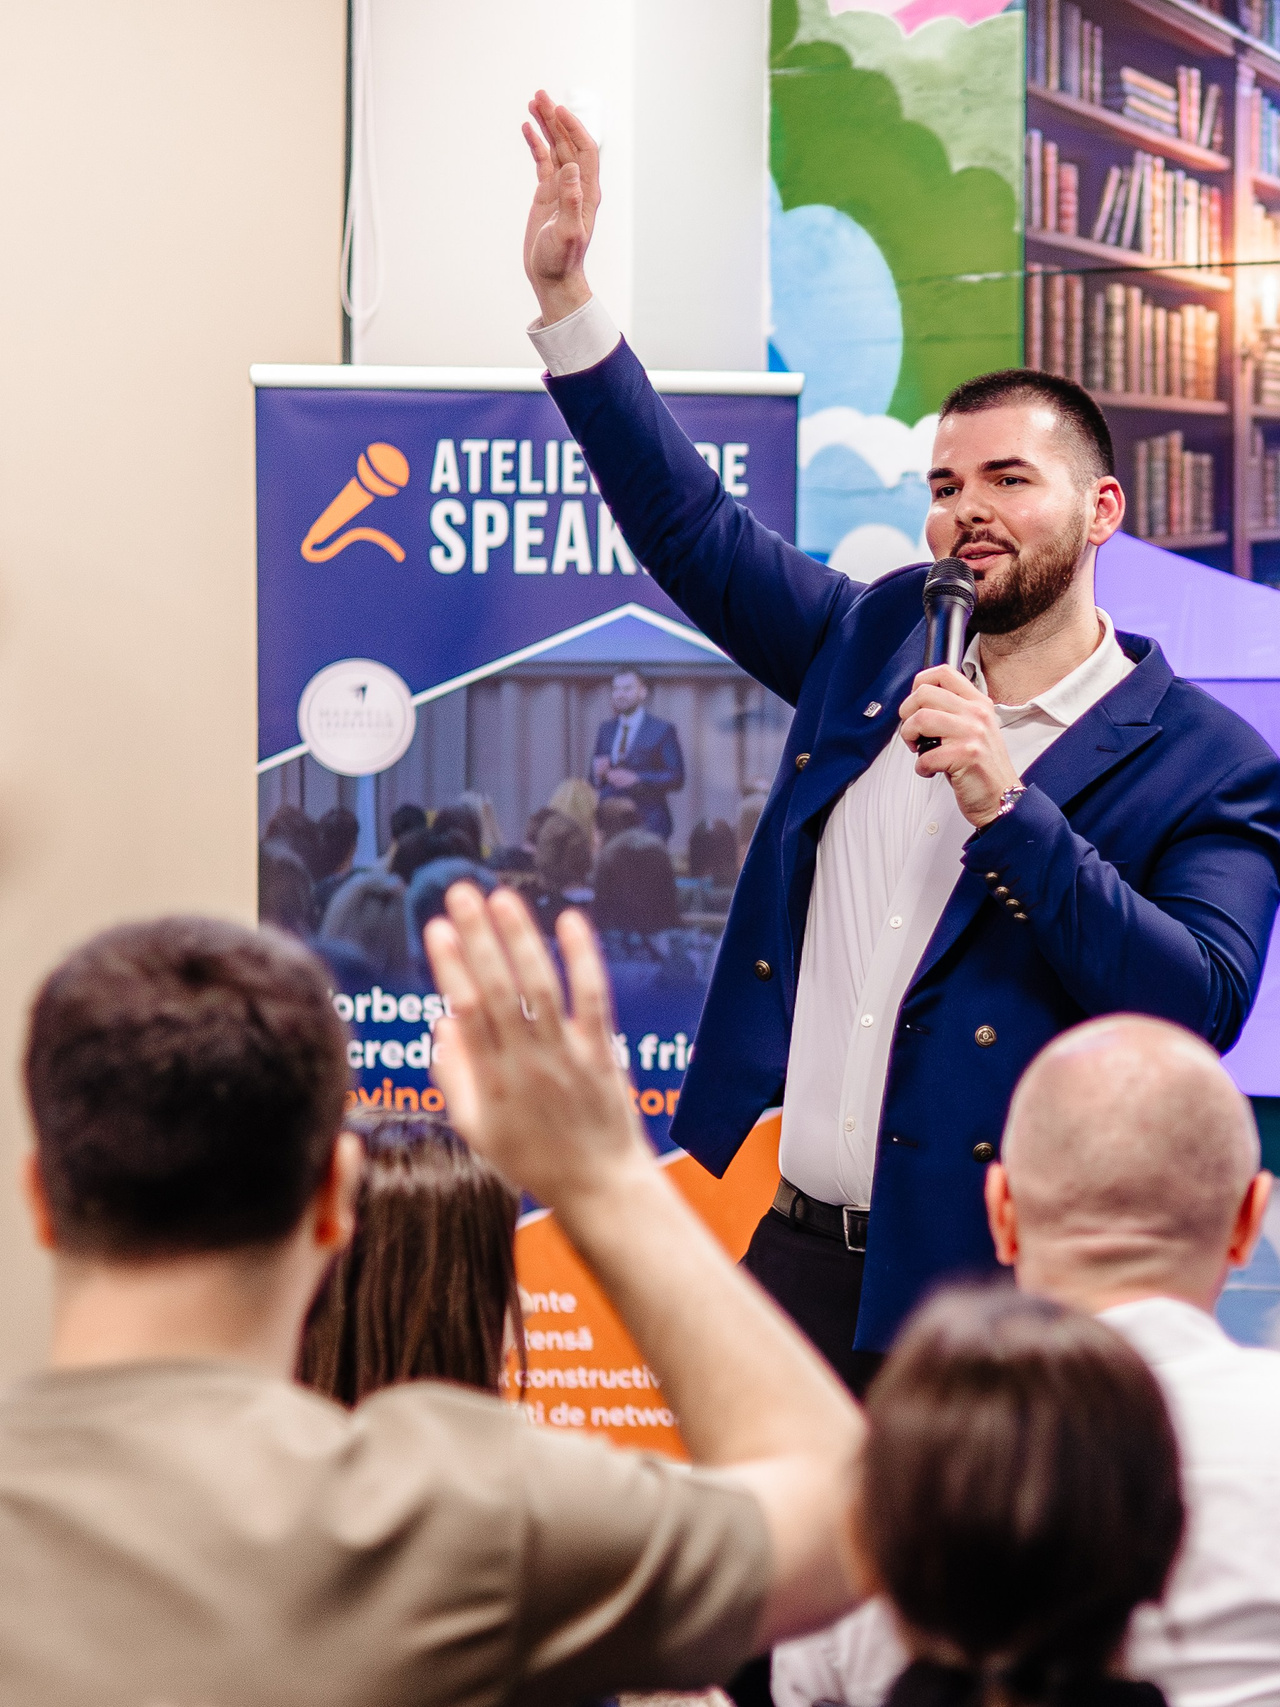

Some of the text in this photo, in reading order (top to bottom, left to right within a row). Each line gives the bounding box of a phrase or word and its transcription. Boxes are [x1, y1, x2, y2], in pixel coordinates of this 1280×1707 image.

[429, 438, 600, 496] ATELIE
[428, 499, 649, 575] SPEAK
[549, 1402, 586, 1427] de
[590, 1403, 678, 1428] netwo
